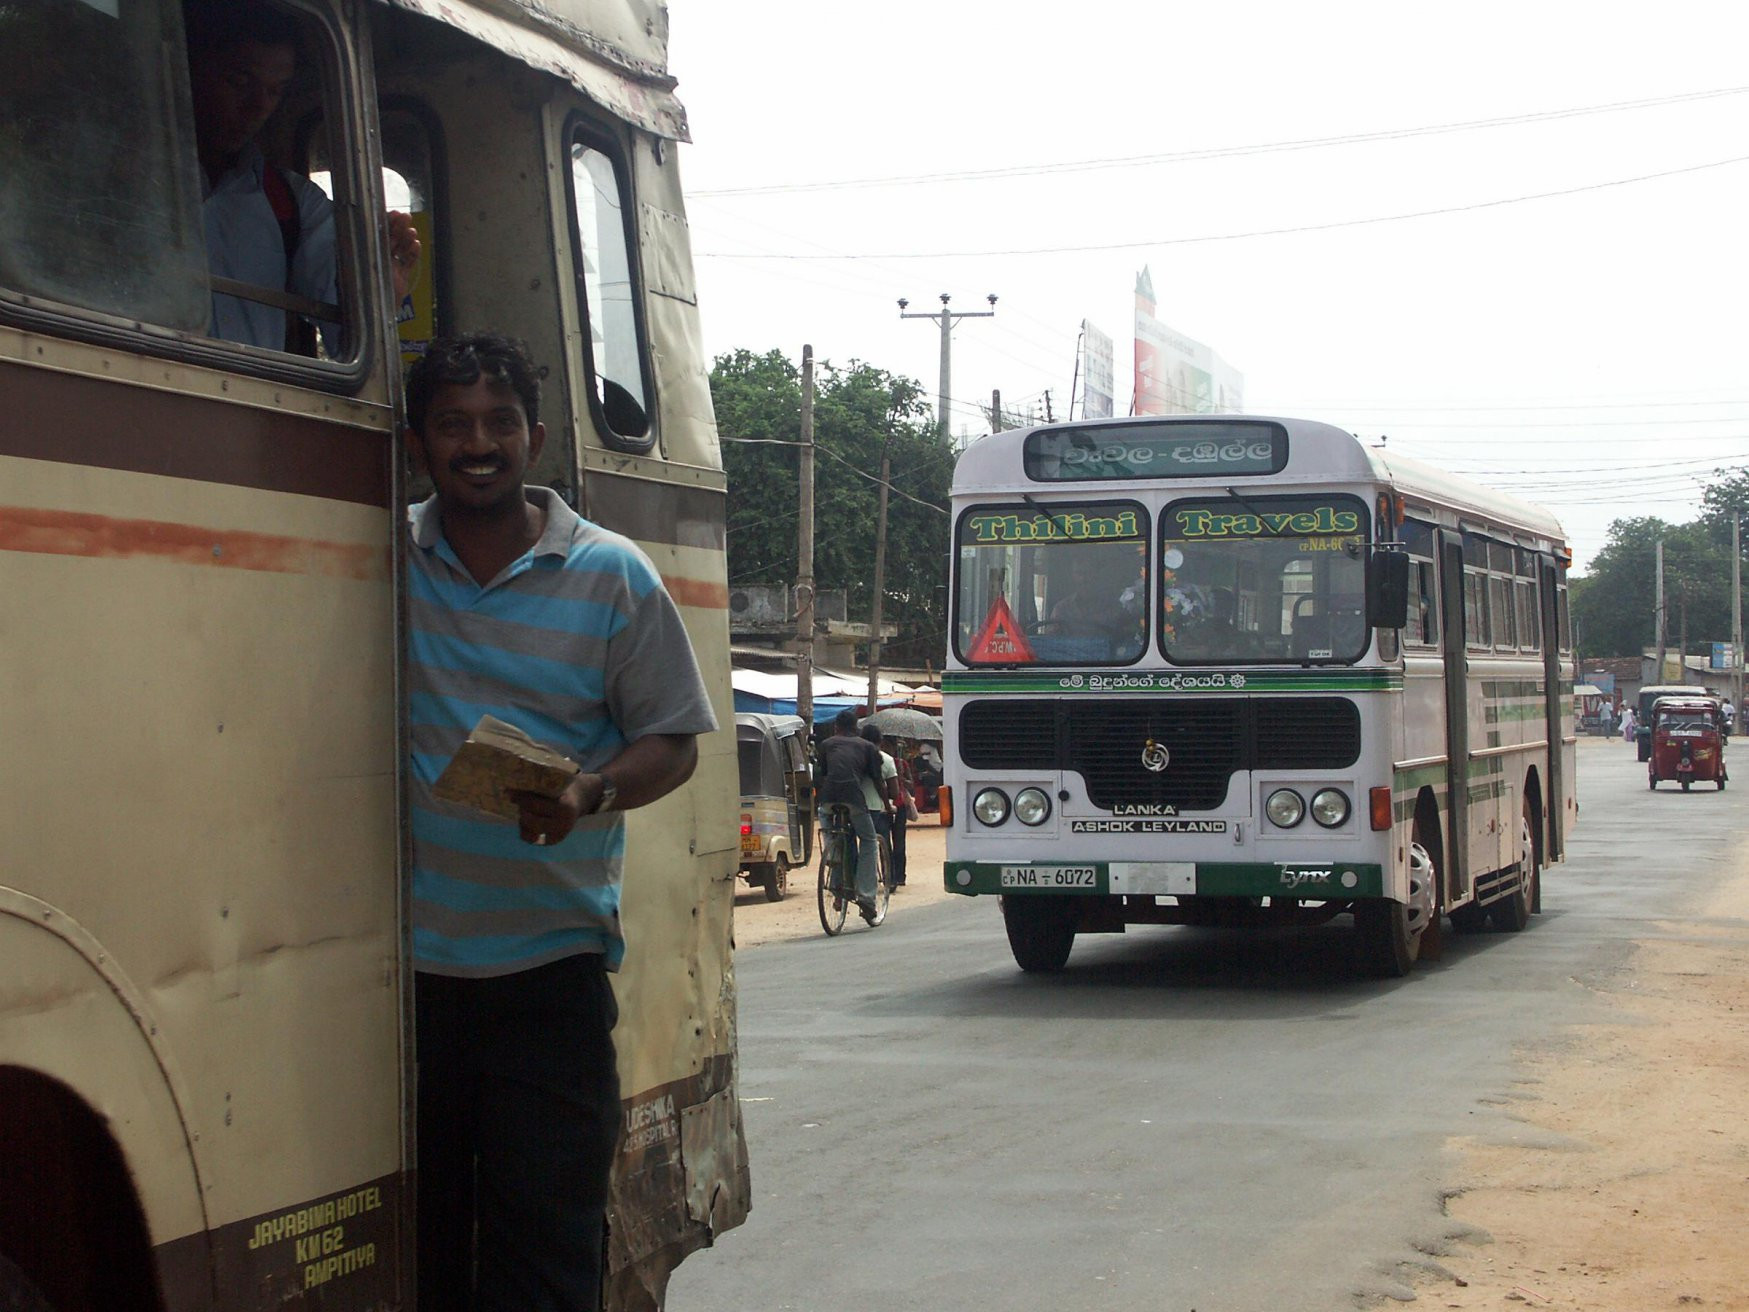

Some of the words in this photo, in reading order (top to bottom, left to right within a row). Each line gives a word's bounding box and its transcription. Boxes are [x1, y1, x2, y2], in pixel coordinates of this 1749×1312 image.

[970, 511, 1138, 541] Thilini
[1176, 507, 1358, 536] Travels
[1073, 821, 1134, 832] ASHOK
[1142, 821, 1225, 832] LEYLAND
[1114, 804, 1176, 815] LANKA
[1280, 865, 1332, 888] Lynx
[336, 1187, 382, 1221] HOTEL
[295, 1234, 321, 1264] KM
[322, 1226, 344, 1254] 62
[304, 1242, 376, 1289] AMPITIYA
